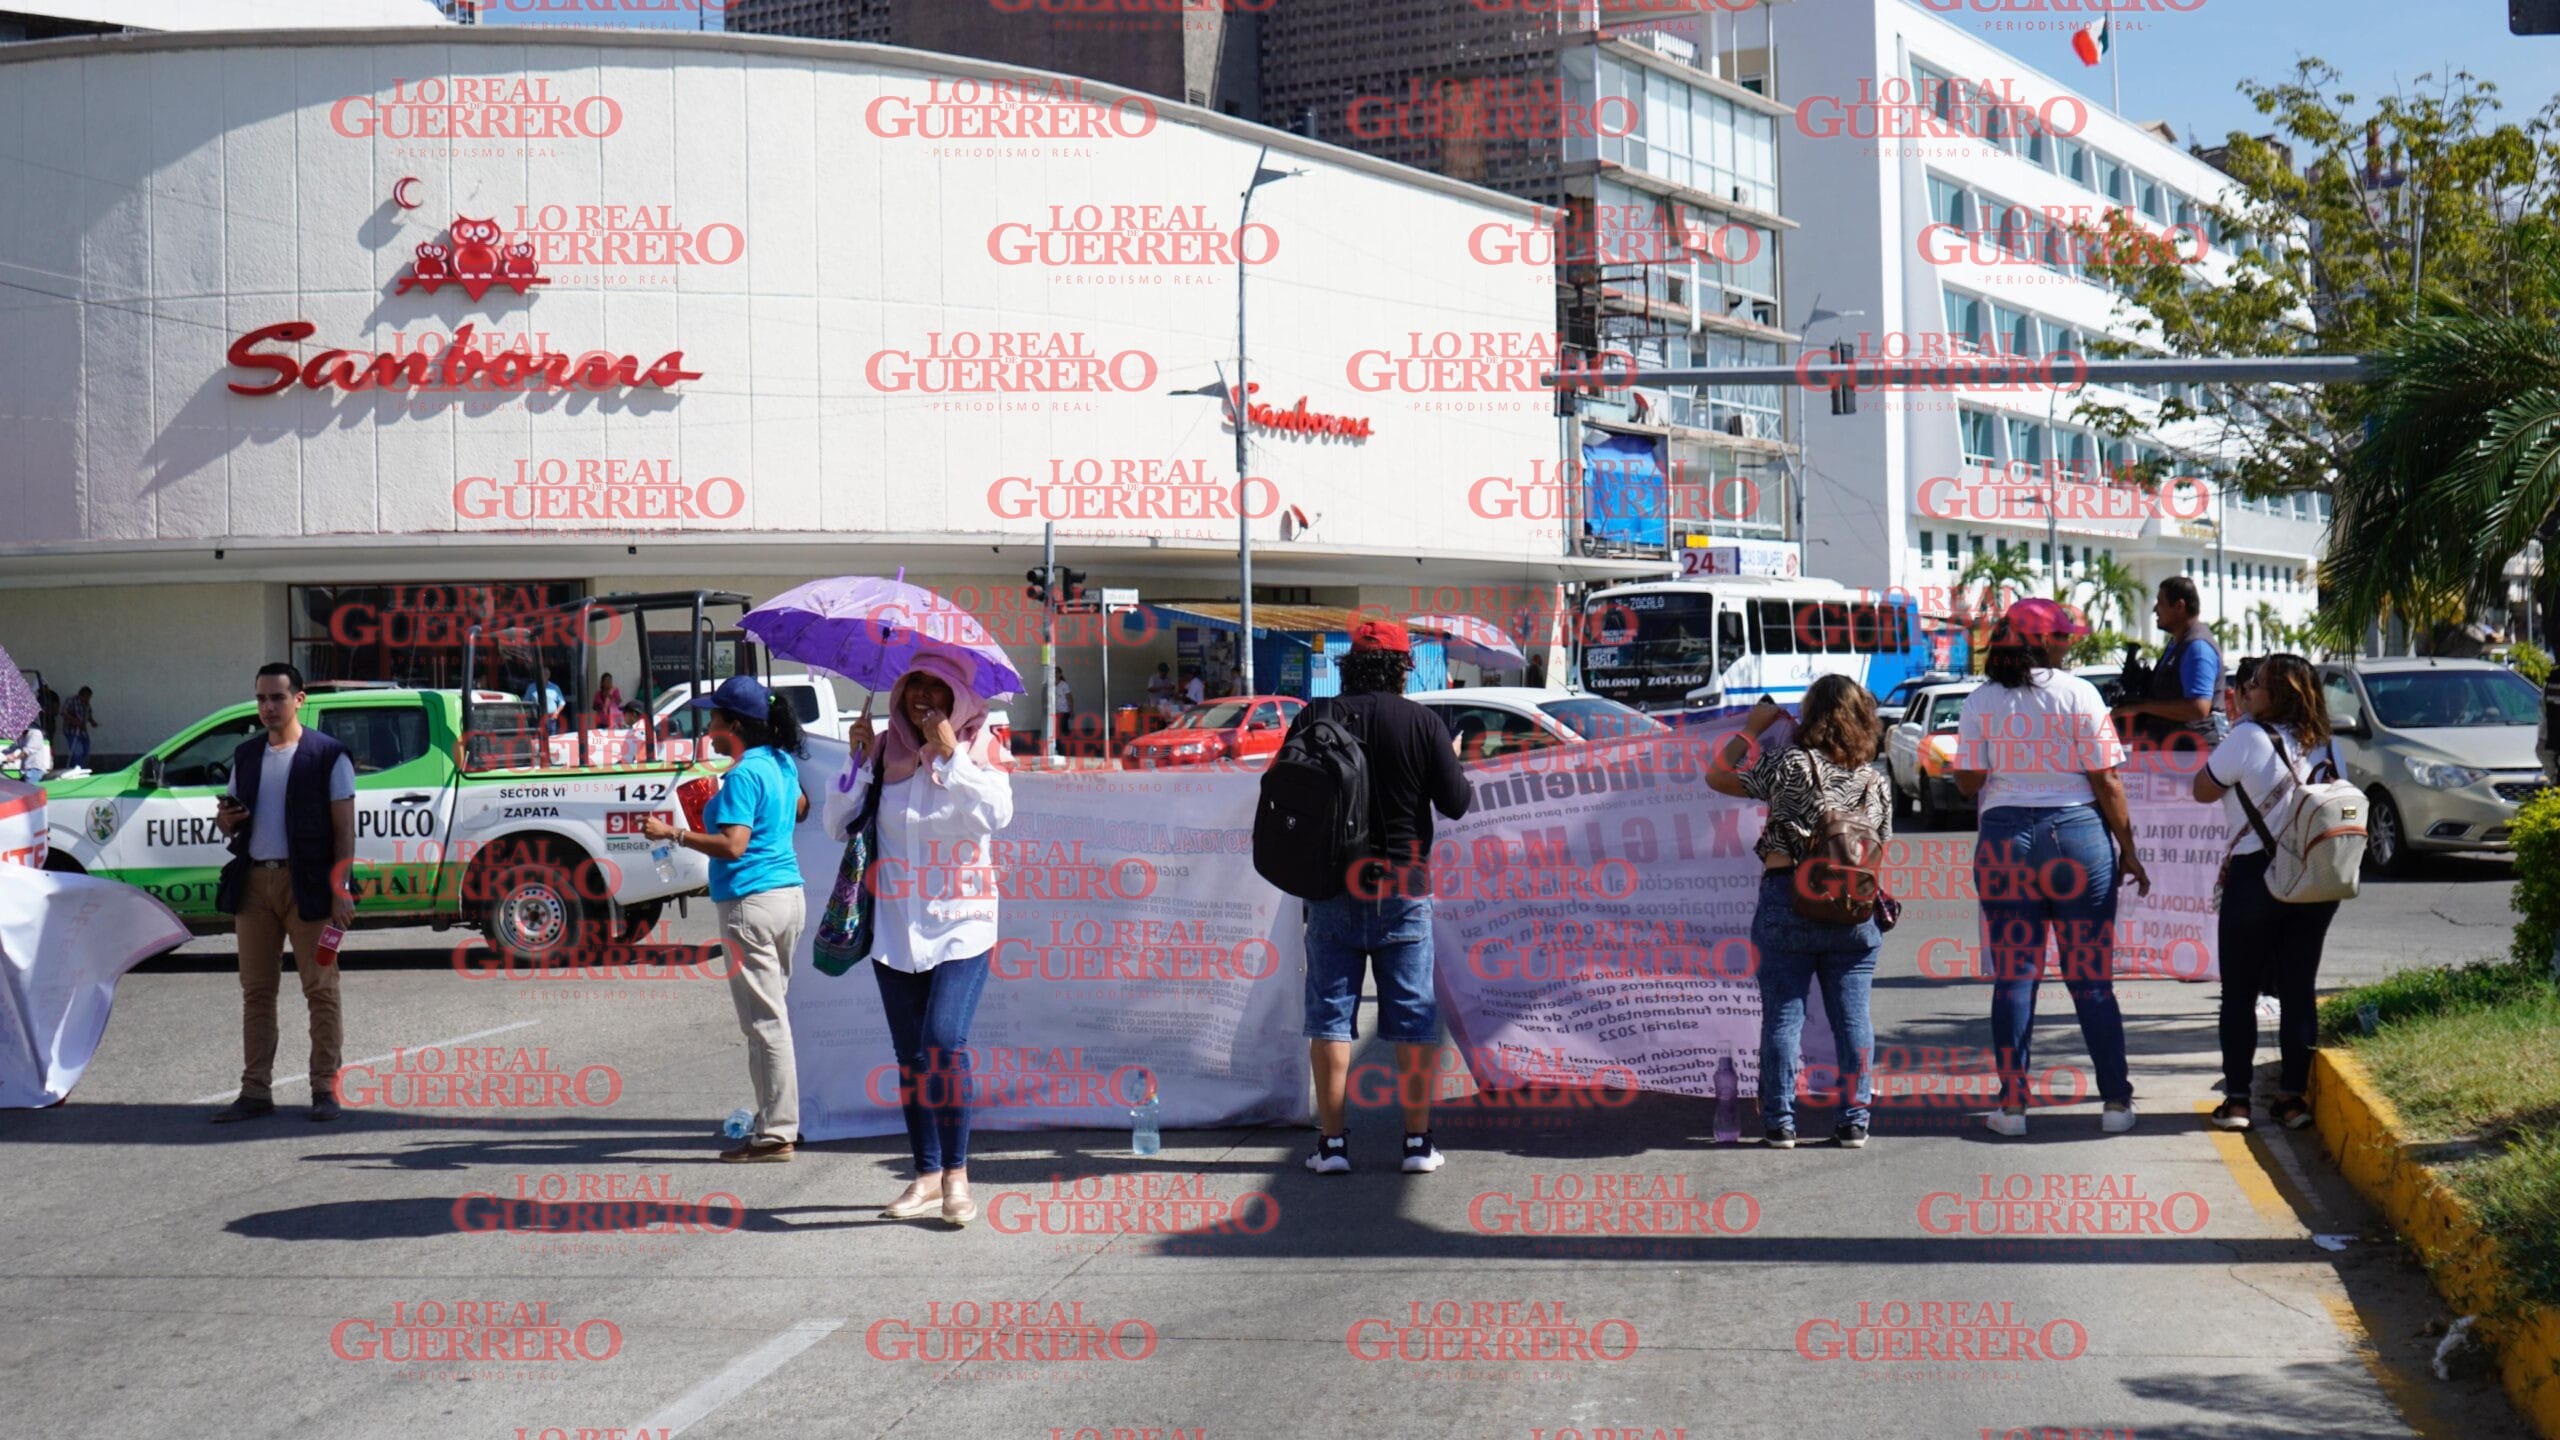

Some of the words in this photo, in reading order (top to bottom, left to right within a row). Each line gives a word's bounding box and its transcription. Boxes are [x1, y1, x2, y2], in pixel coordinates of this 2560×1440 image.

[228, 320, 703, 397] Sanborns
[1228, 382, 1375, 440] Sanborns
[1684, 551, 1714, 575] 24
[1591, 677, 1641, 689] COLOSIO
[1647, 674, 1703, 687] ZOCALO
[500, 788, 546, 799] SECTOR
[549, 787, 566, 798] VI
[615, 784, 667, 802] 142
[504, 806, 559, 818] ZAPATA
[355, 809, 435, 838] PULCO
